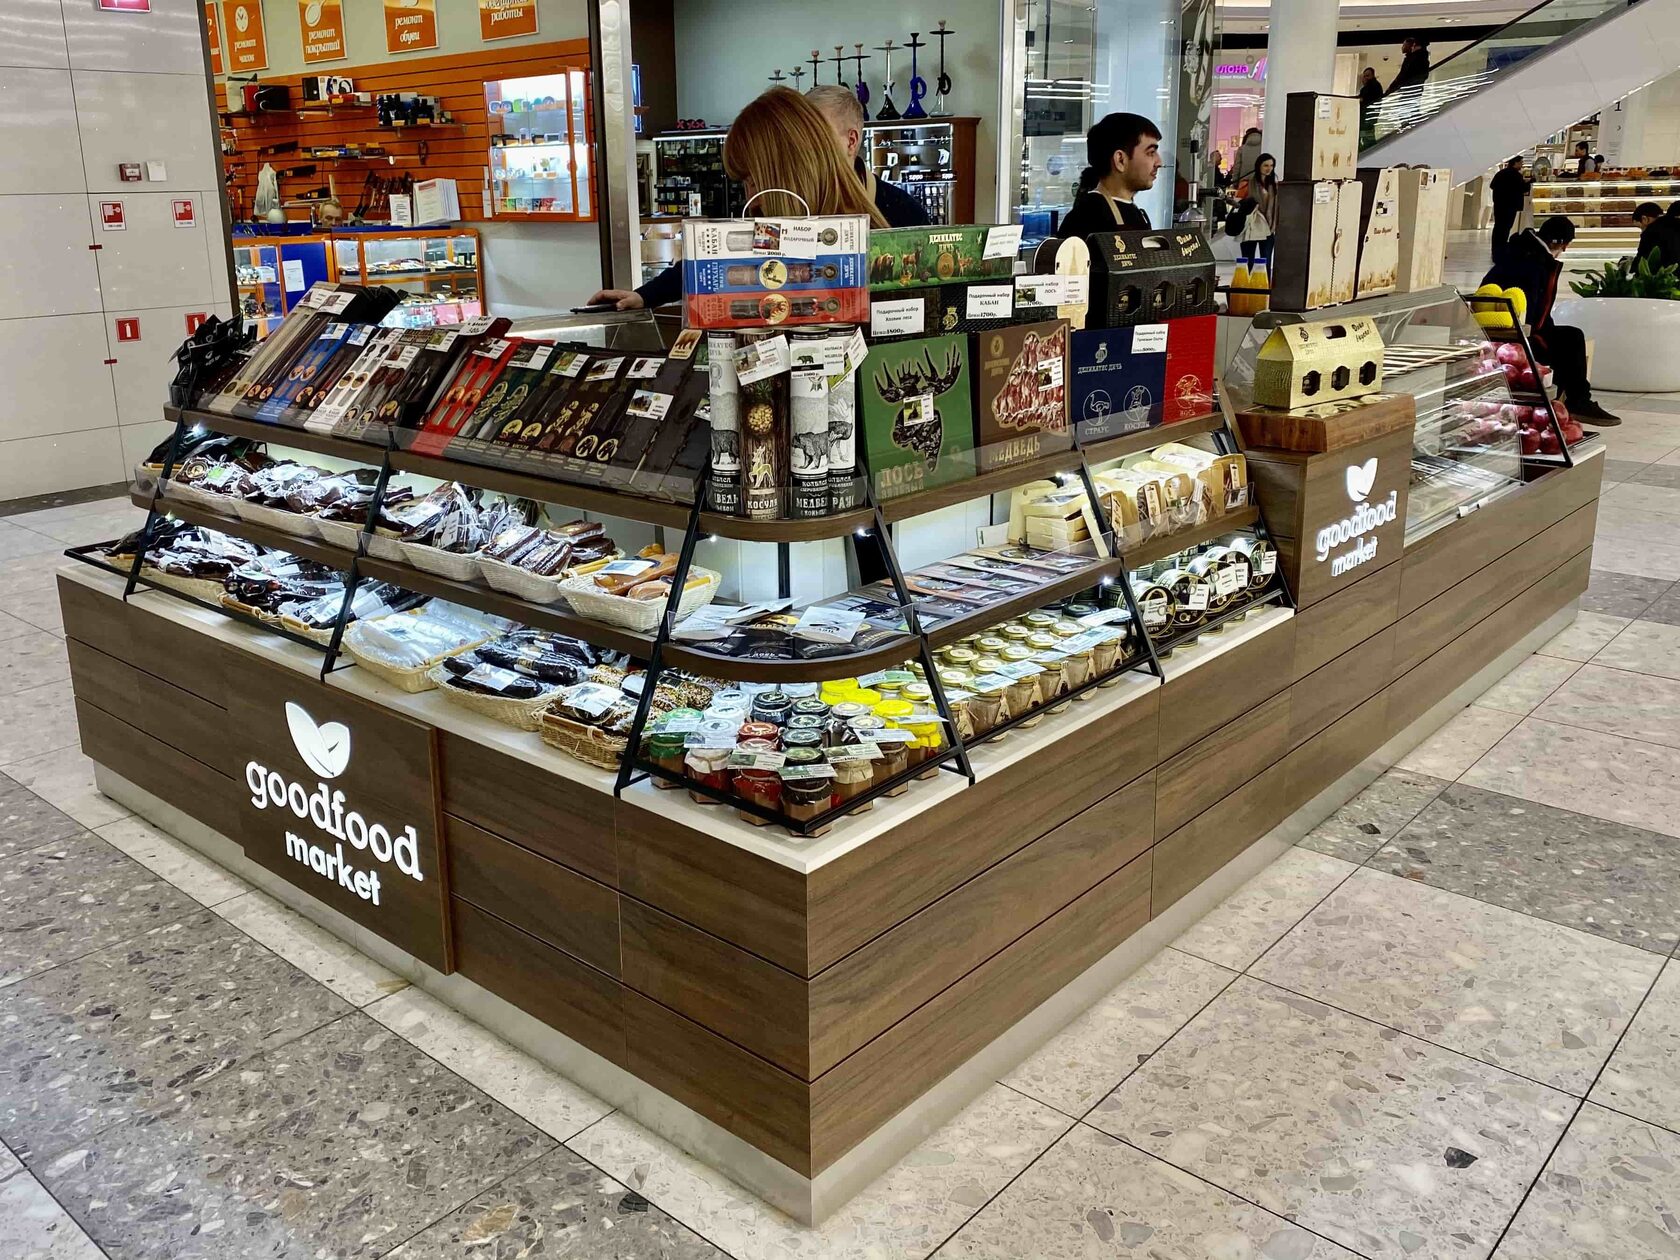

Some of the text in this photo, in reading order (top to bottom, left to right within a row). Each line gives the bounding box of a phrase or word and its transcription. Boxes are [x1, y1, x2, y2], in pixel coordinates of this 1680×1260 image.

[308, 28, 336, 43] ремонт
[395, 14, 423, 29] ремонт
[490, 7, 524, 26] работы
[1316, 490, 1398, 562] goodfood
[1331, 536, 1379, 577] market
[245, 760, 424, 882] goodfood
[284, 830, 382, 906] market
